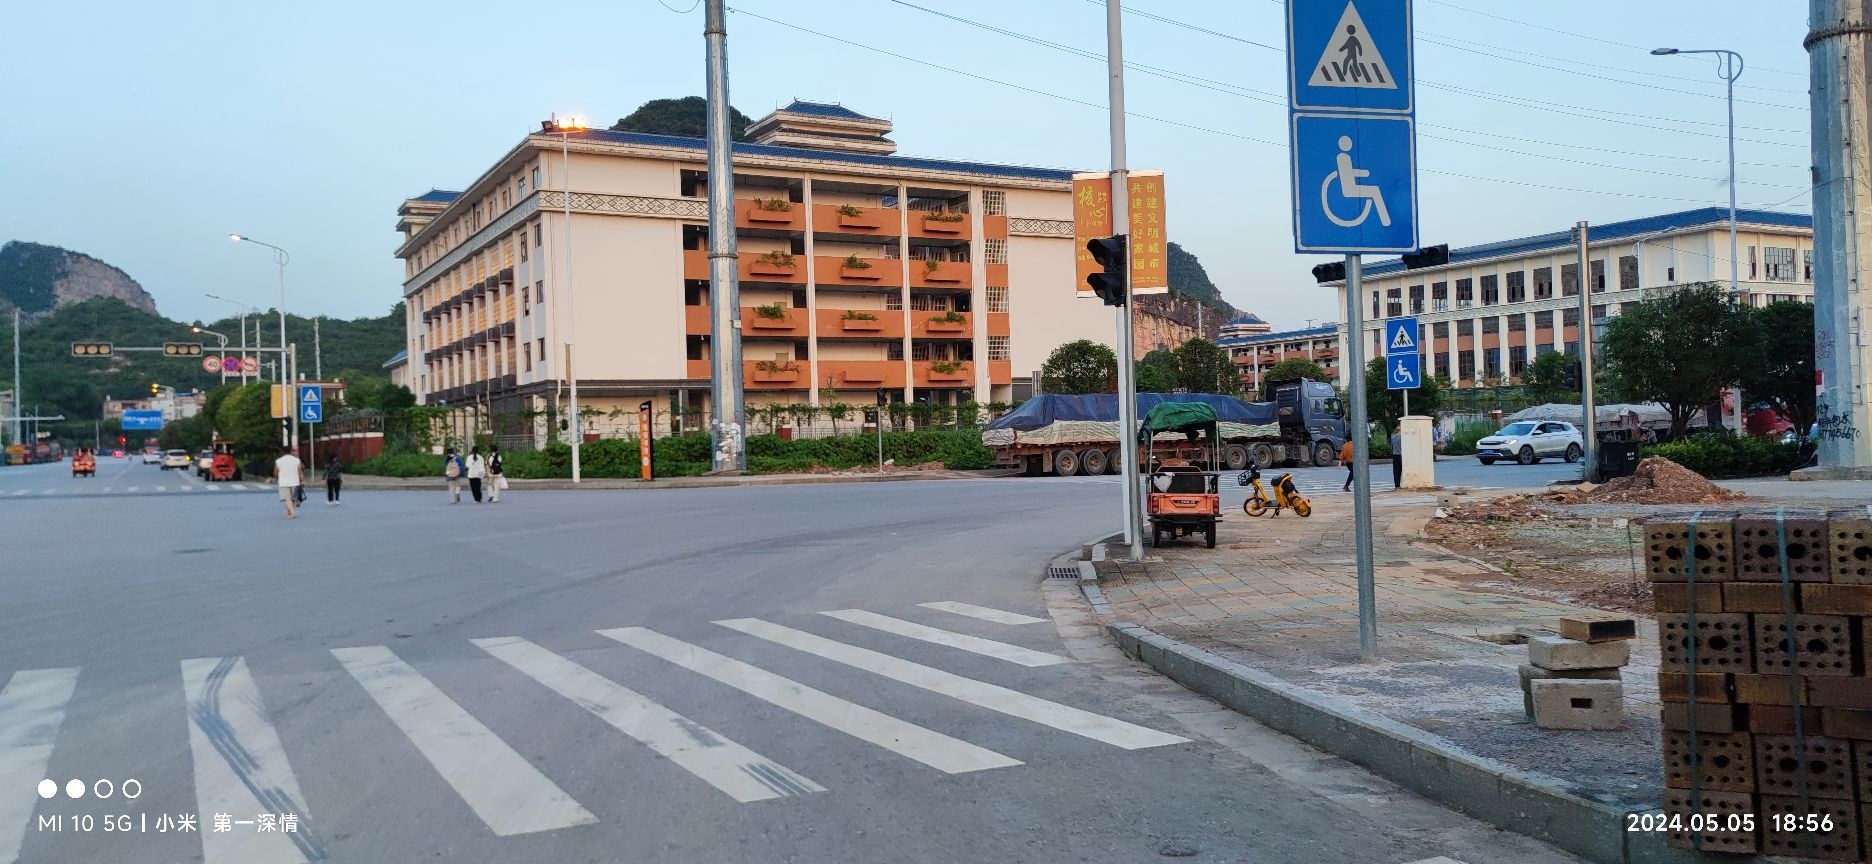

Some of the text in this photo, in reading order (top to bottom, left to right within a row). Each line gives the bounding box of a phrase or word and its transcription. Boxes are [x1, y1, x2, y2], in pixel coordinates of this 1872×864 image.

[1131, 182, 1144, 269] 共建美好家园
[1146, 182, 1159, 269] 创建文明城市
